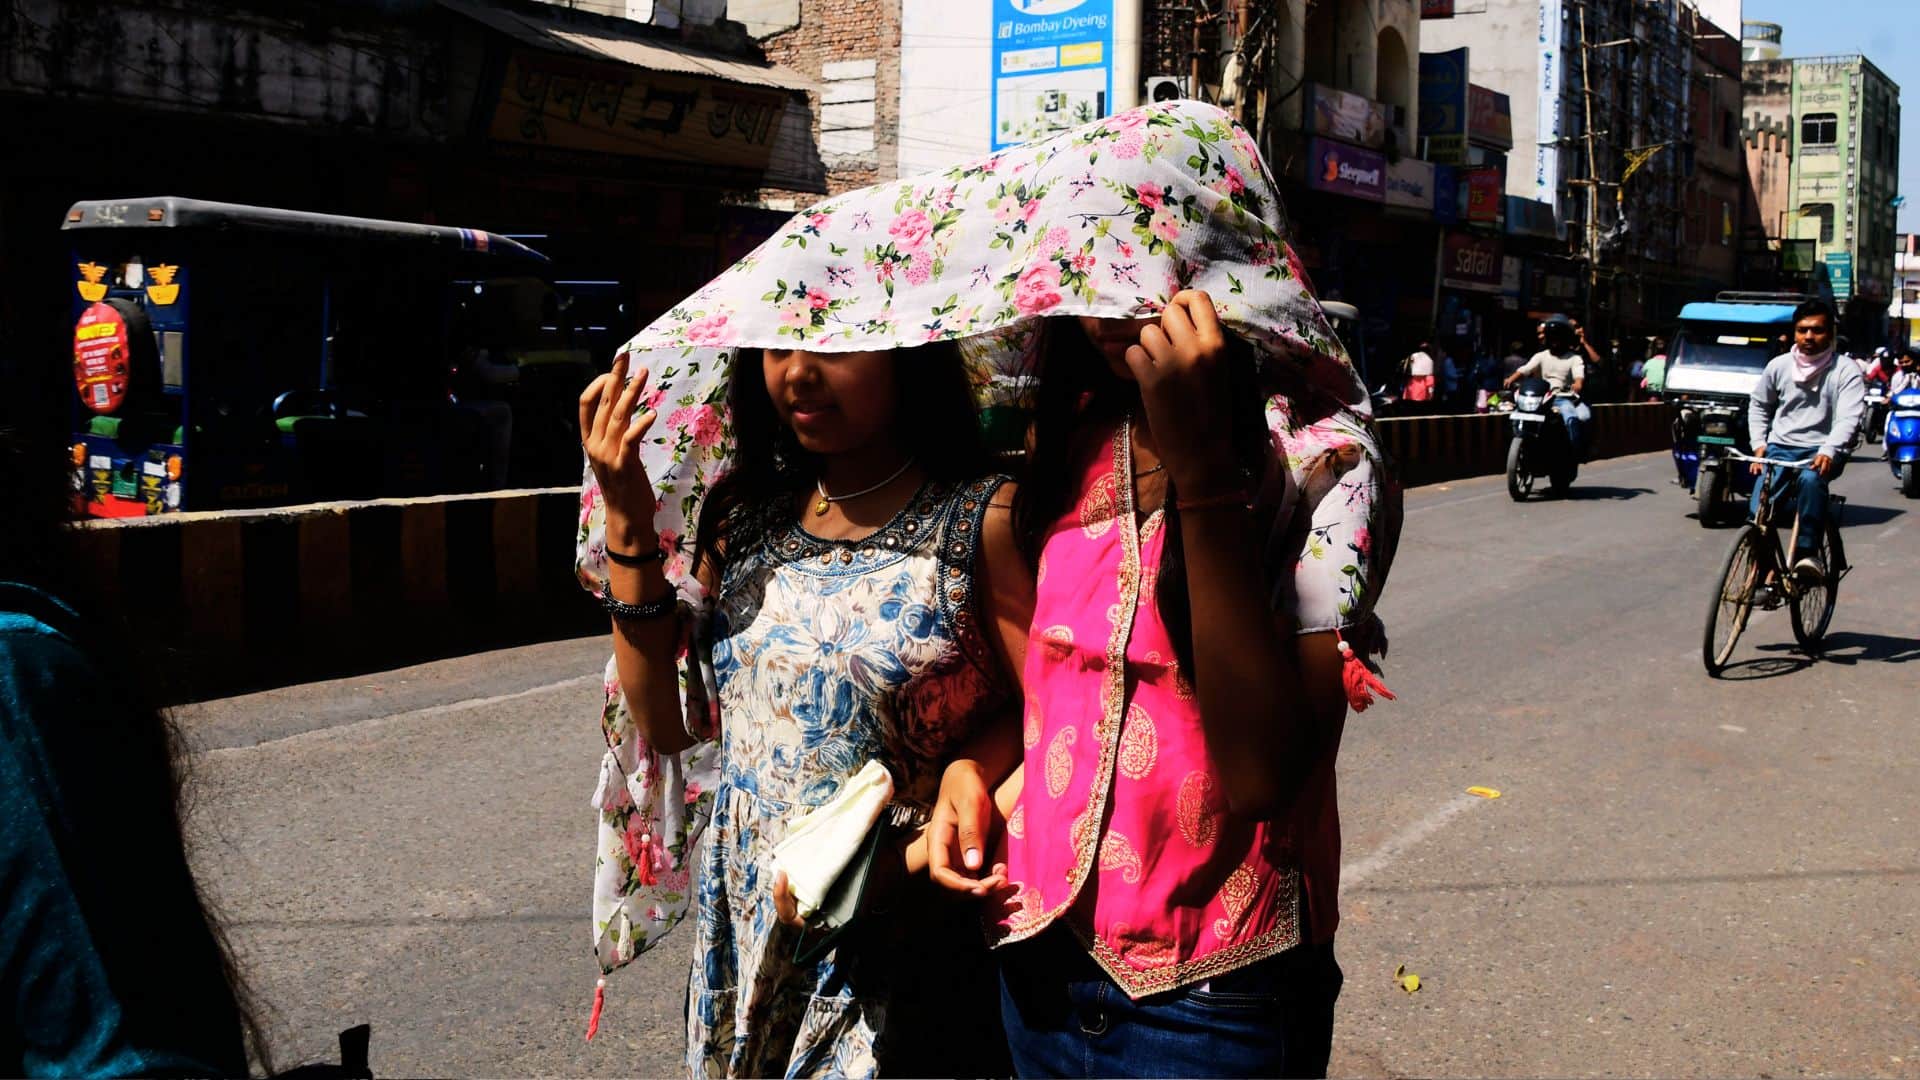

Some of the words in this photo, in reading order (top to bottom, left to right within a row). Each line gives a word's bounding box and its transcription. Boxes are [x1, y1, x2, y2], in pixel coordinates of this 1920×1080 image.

[1014, 18, 1060, 36] Bombay
[1062, 14, 1107, 30] Dyeing
[1455, 243, 1494, 277] safari
